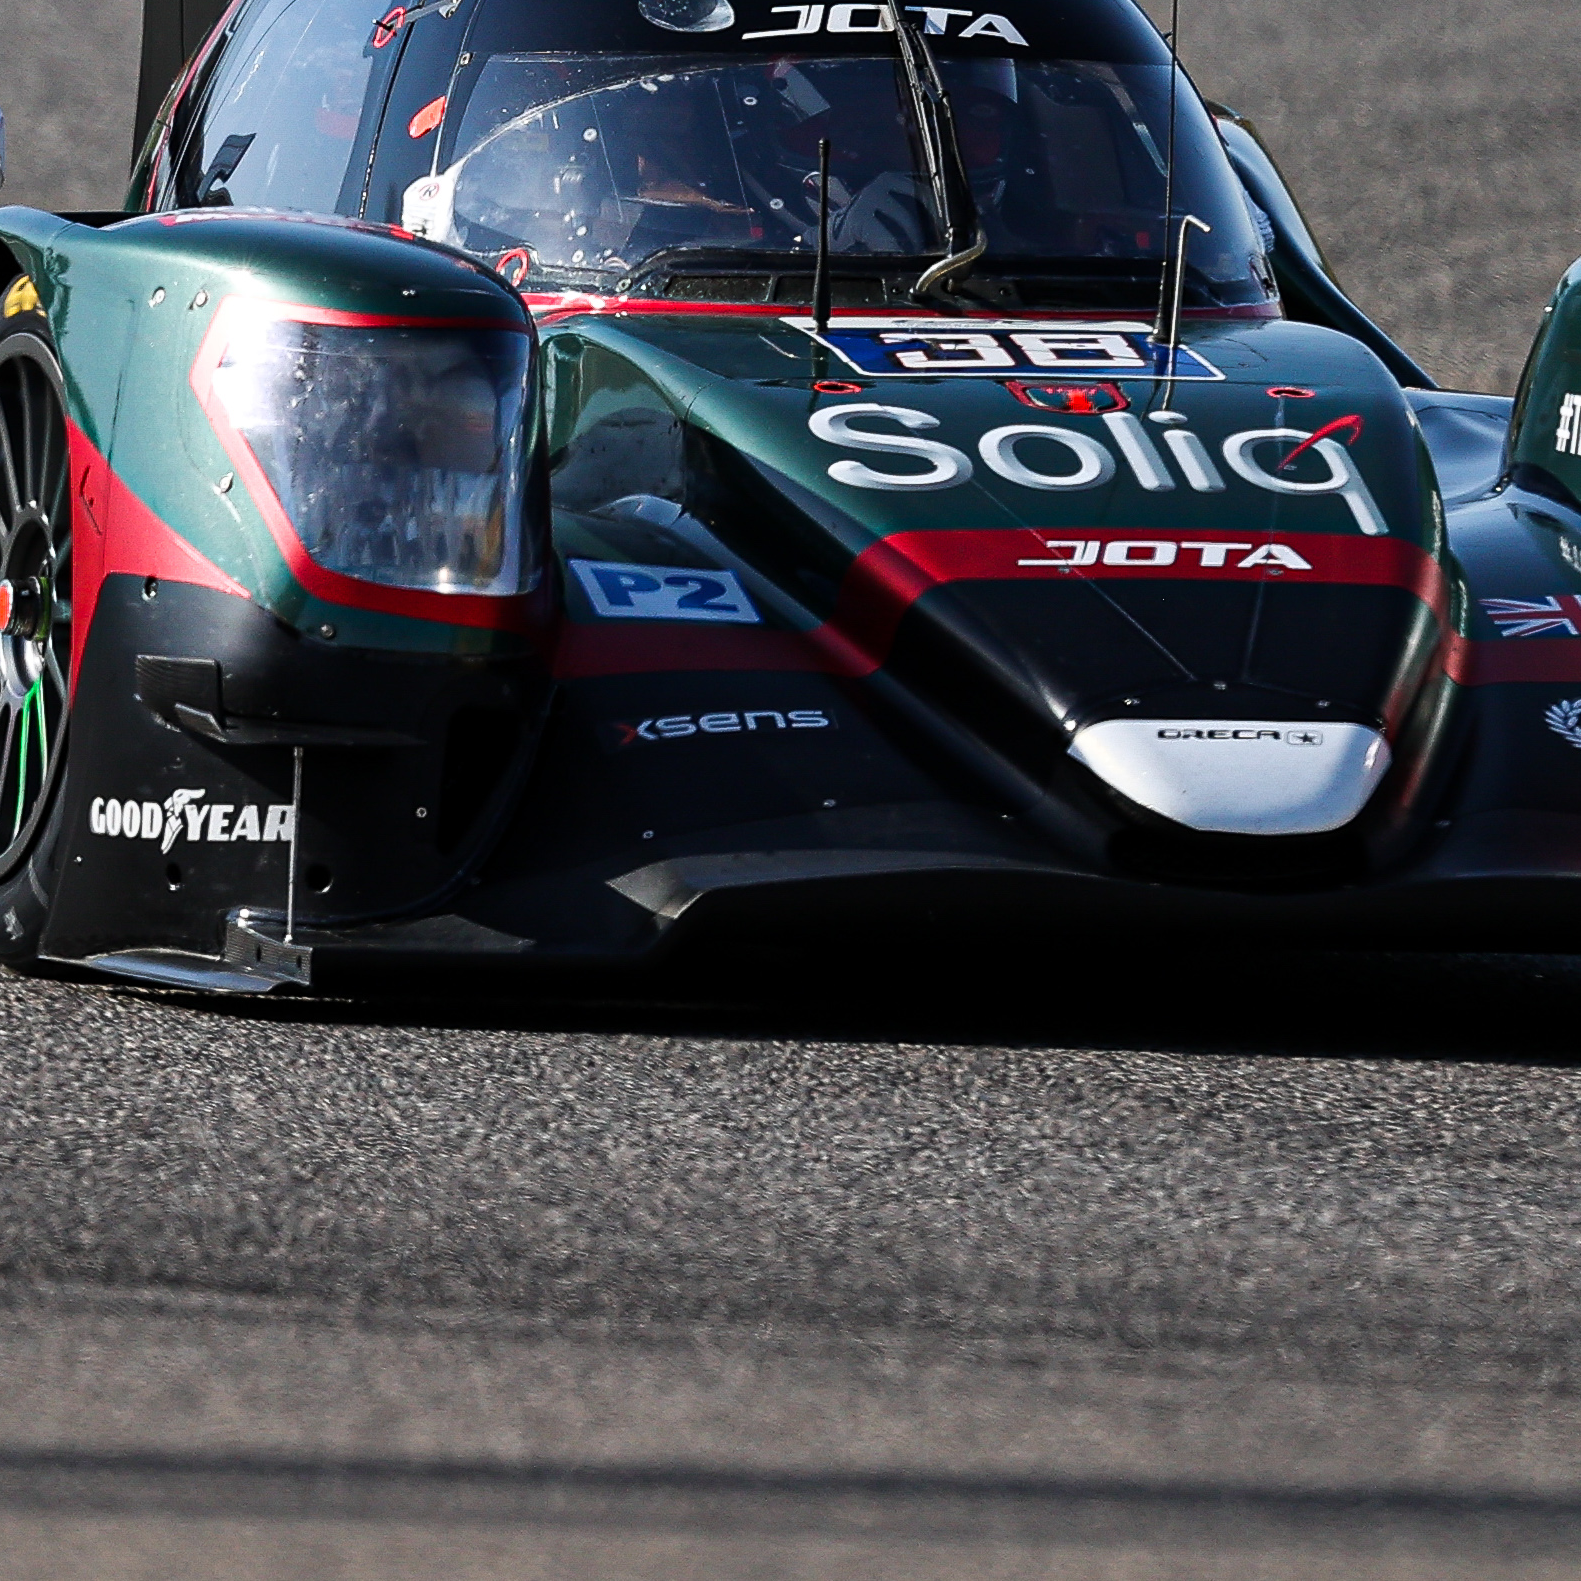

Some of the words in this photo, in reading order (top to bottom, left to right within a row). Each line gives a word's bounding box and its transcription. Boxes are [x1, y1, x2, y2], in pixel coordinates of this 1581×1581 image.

[741, 3, 1030, 47] JOTA
[880, 333, 1145, 368] 38
[809, 403, 1390, 536] Soliq
[1018, 540, 1313, 569] JOTA
[591, 568, 740, 612] P2
[1157, 727, 1281, 740] ORECA
[90, 794, 296, 843] GOODYEAR
